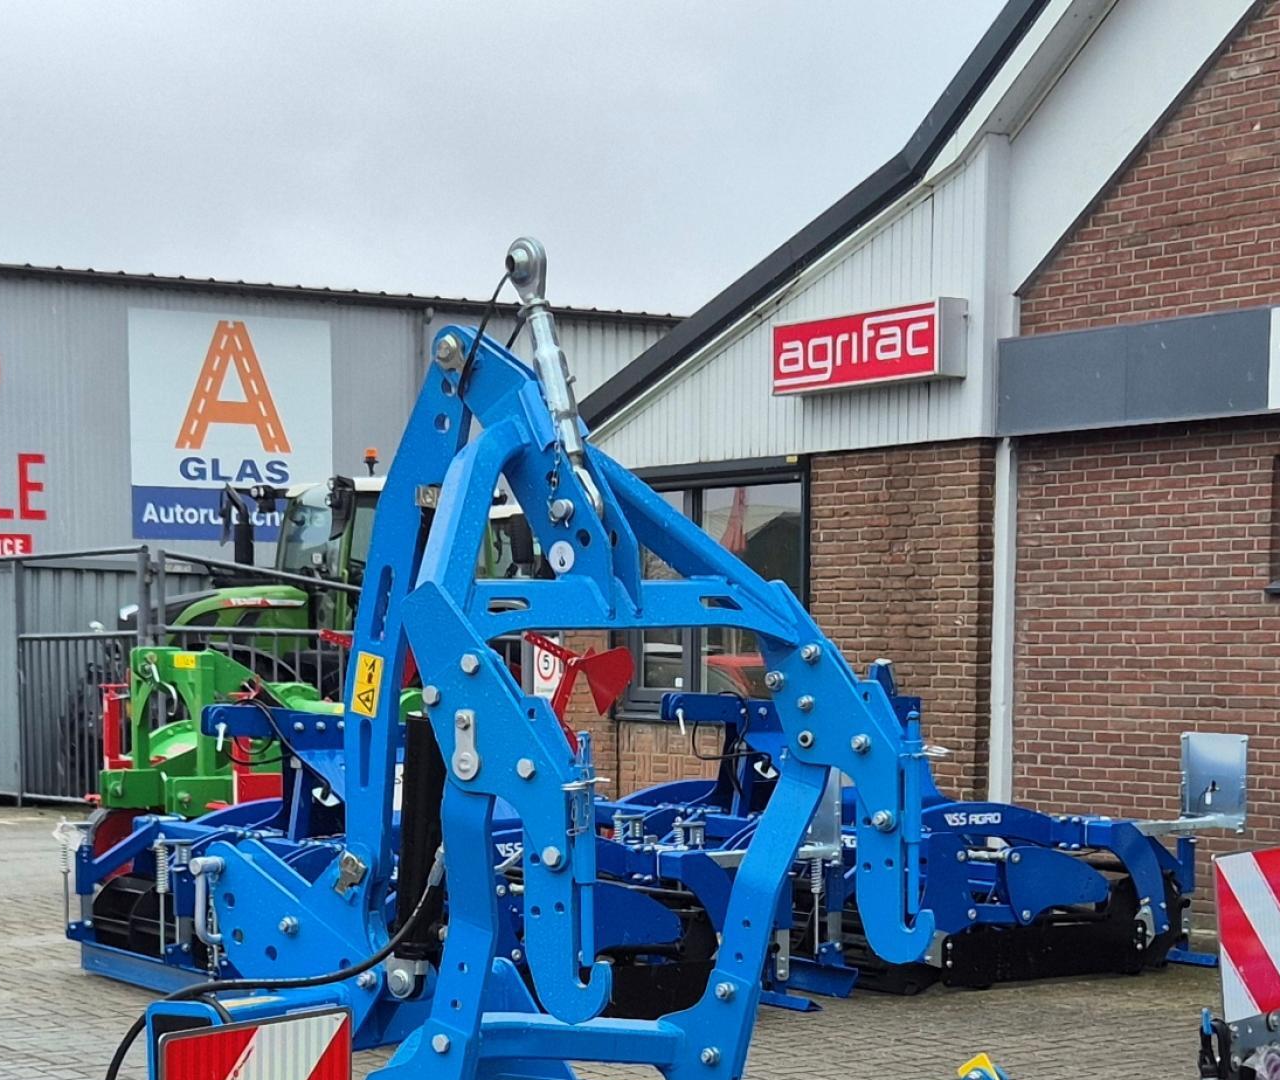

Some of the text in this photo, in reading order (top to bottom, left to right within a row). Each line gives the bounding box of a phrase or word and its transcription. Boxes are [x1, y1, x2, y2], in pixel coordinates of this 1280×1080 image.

[774, 307, 936, 387] agrifac
[174, 320, 292, 454] A
[179, 456, 290, 484] GLAS
[543, 653, 550, 671] 5
[968, 811, 1002, 825] AGRO
